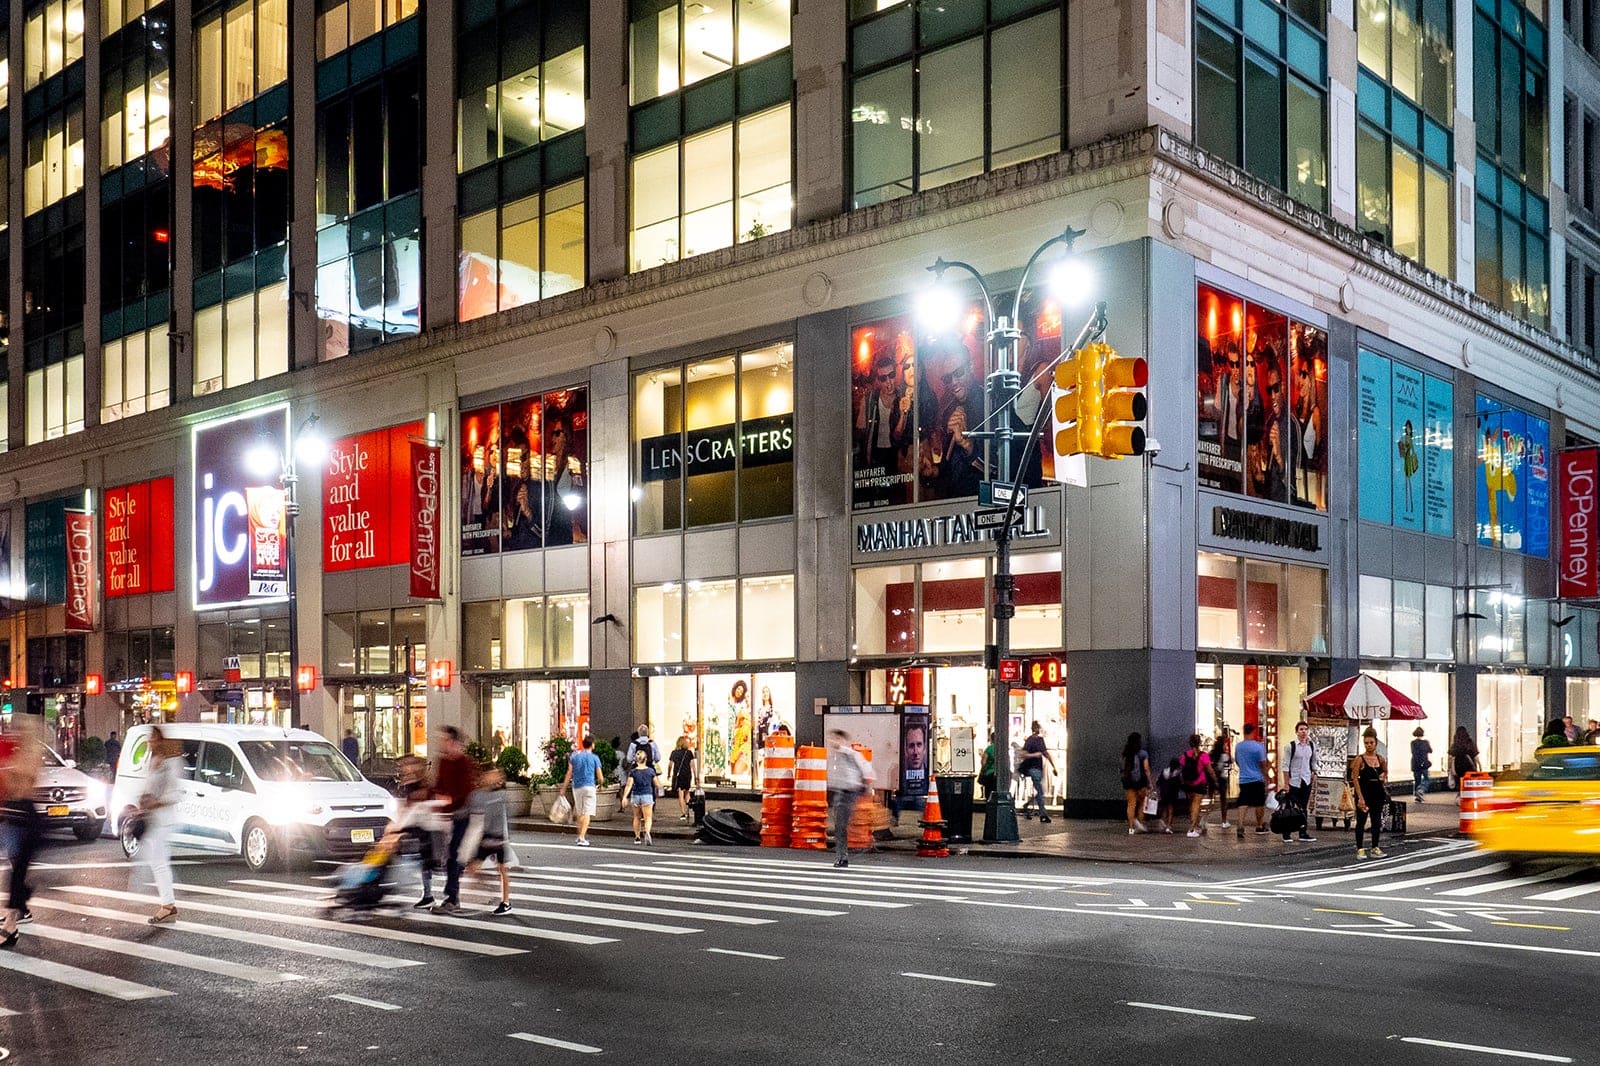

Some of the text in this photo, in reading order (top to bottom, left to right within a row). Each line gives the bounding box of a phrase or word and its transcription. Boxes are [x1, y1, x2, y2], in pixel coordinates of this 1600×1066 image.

[330, 444, 368, 480] Style
[651, 428, 792, 469] LENSCRAFTERS
[854, 467, 885, 479] WAYFARER
[870, 473, 914, 487] PRESCRIPTION
[330, 473, 360, 504] and
[109, 493, 136, 522] Style
[330, 504, 370, 533] value
[412, 460, 438, 582] JCPenney
[981, 514, 995, 524] ONE
[109, 517, 130, 542] and
[857, 514, 976, 552] MANHATTAN
[1563, 461, 1595, 587] JCPenney
[109, 542, 137, 564] value
[330, 530, 375, 562] for all
[69, 521, 92, 622] JCPenney
[110, 564, 141, 590] for all
[258, 583, 278, 593] P&G
[1049, 662, 1057, 681] 8
[1351, 705, 1387, 719] NUTS
[955, 747, 967, 757] 29
